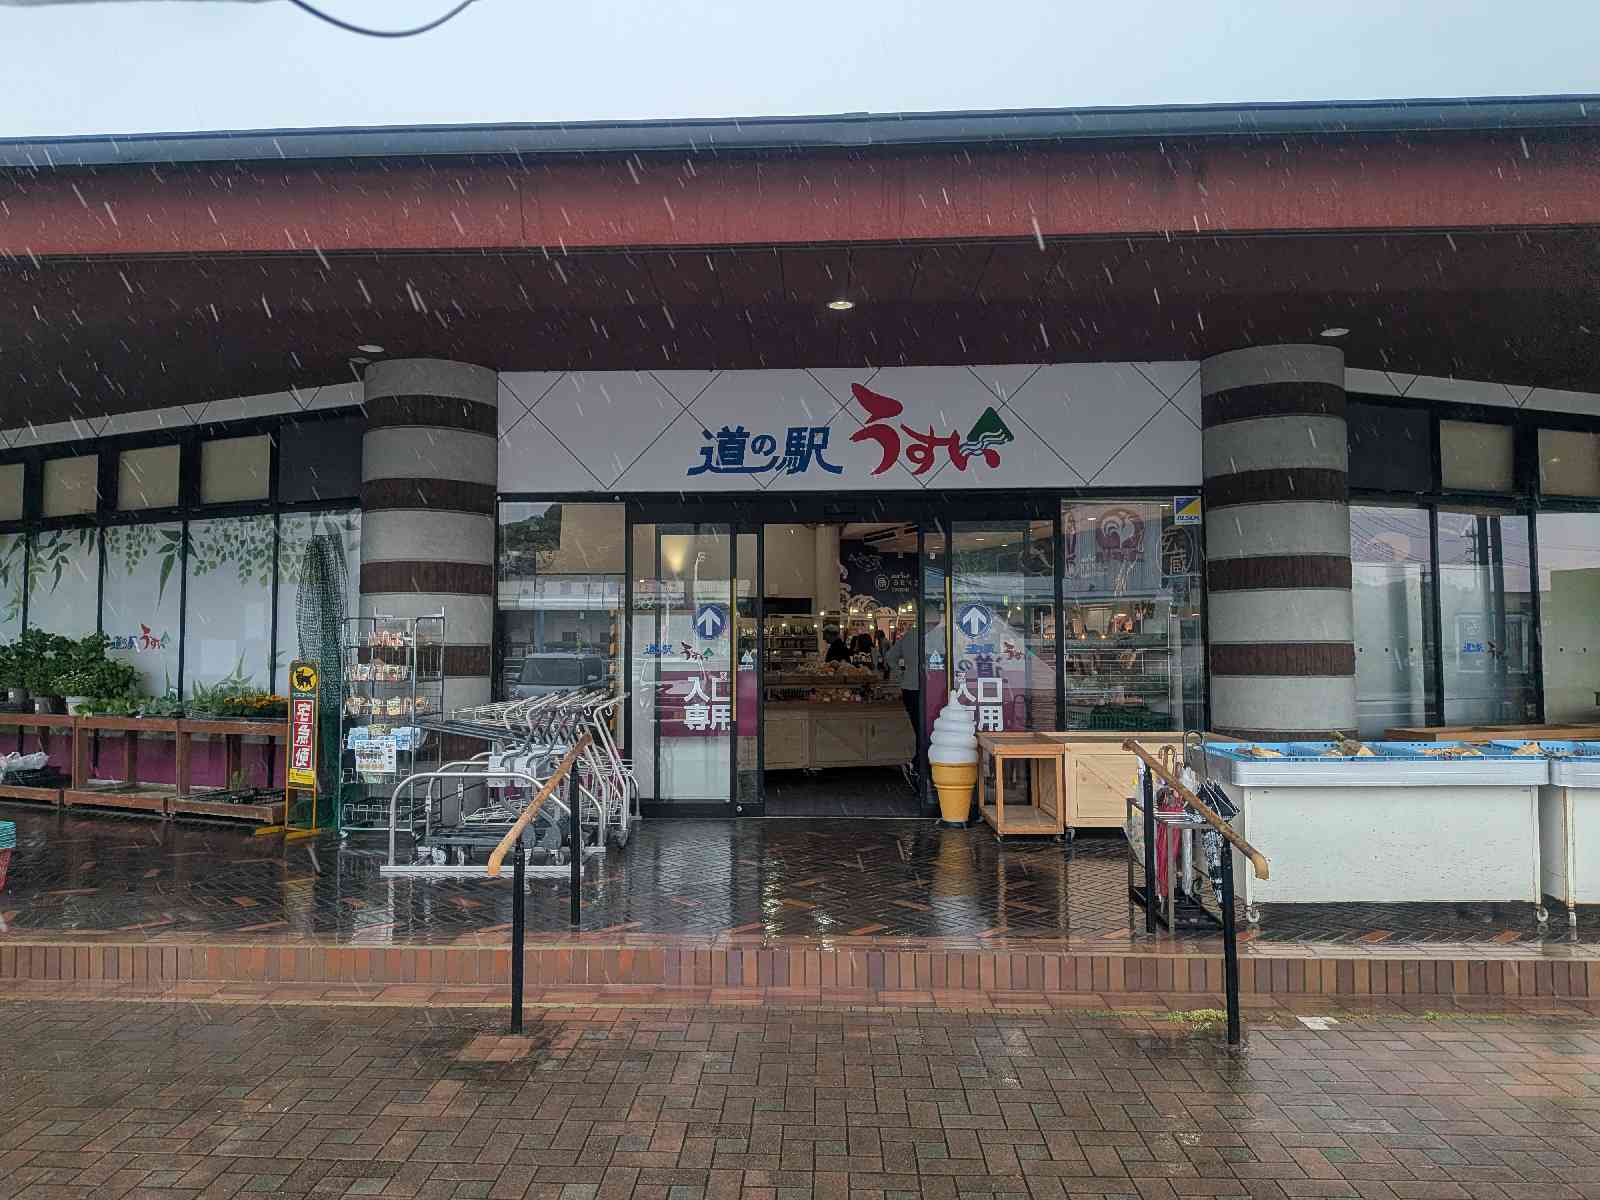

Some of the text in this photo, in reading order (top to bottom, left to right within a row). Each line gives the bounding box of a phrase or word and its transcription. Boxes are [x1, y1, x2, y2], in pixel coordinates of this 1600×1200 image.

[687, 382, 1002, 475] 道の駅 うすい
[684, 676, 731, 702] 入口
[296, 702, 311, 768] 宅急便
[683, 703, 731, 731] 専用
